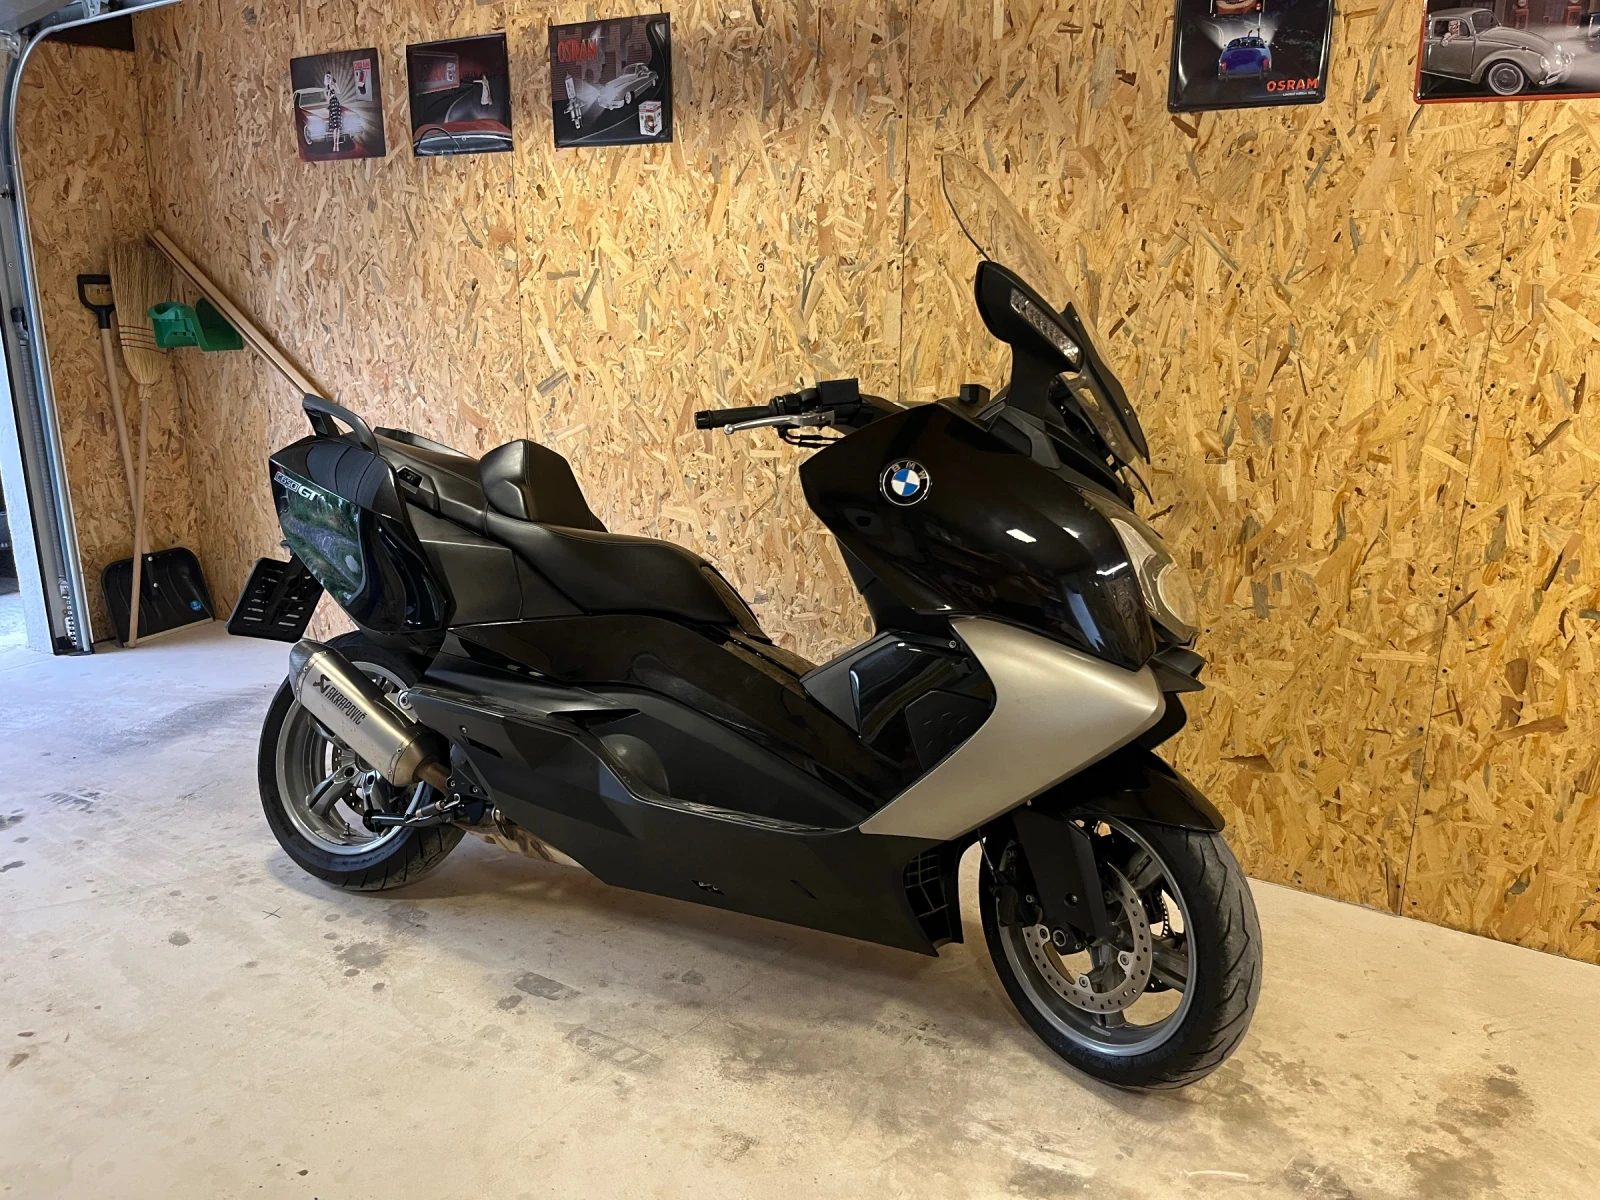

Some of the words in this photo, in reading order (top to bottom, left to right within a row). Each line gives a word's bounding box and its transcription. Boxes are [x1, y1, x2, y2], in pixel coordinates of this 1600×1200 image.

[558, 38, 598, 62] OSRAM
[1266, 77, 1319, 92] OSRAM
[891, 461, 928, 480] BMW
[325, 686, 367, 726] AKRAPOVIČ
